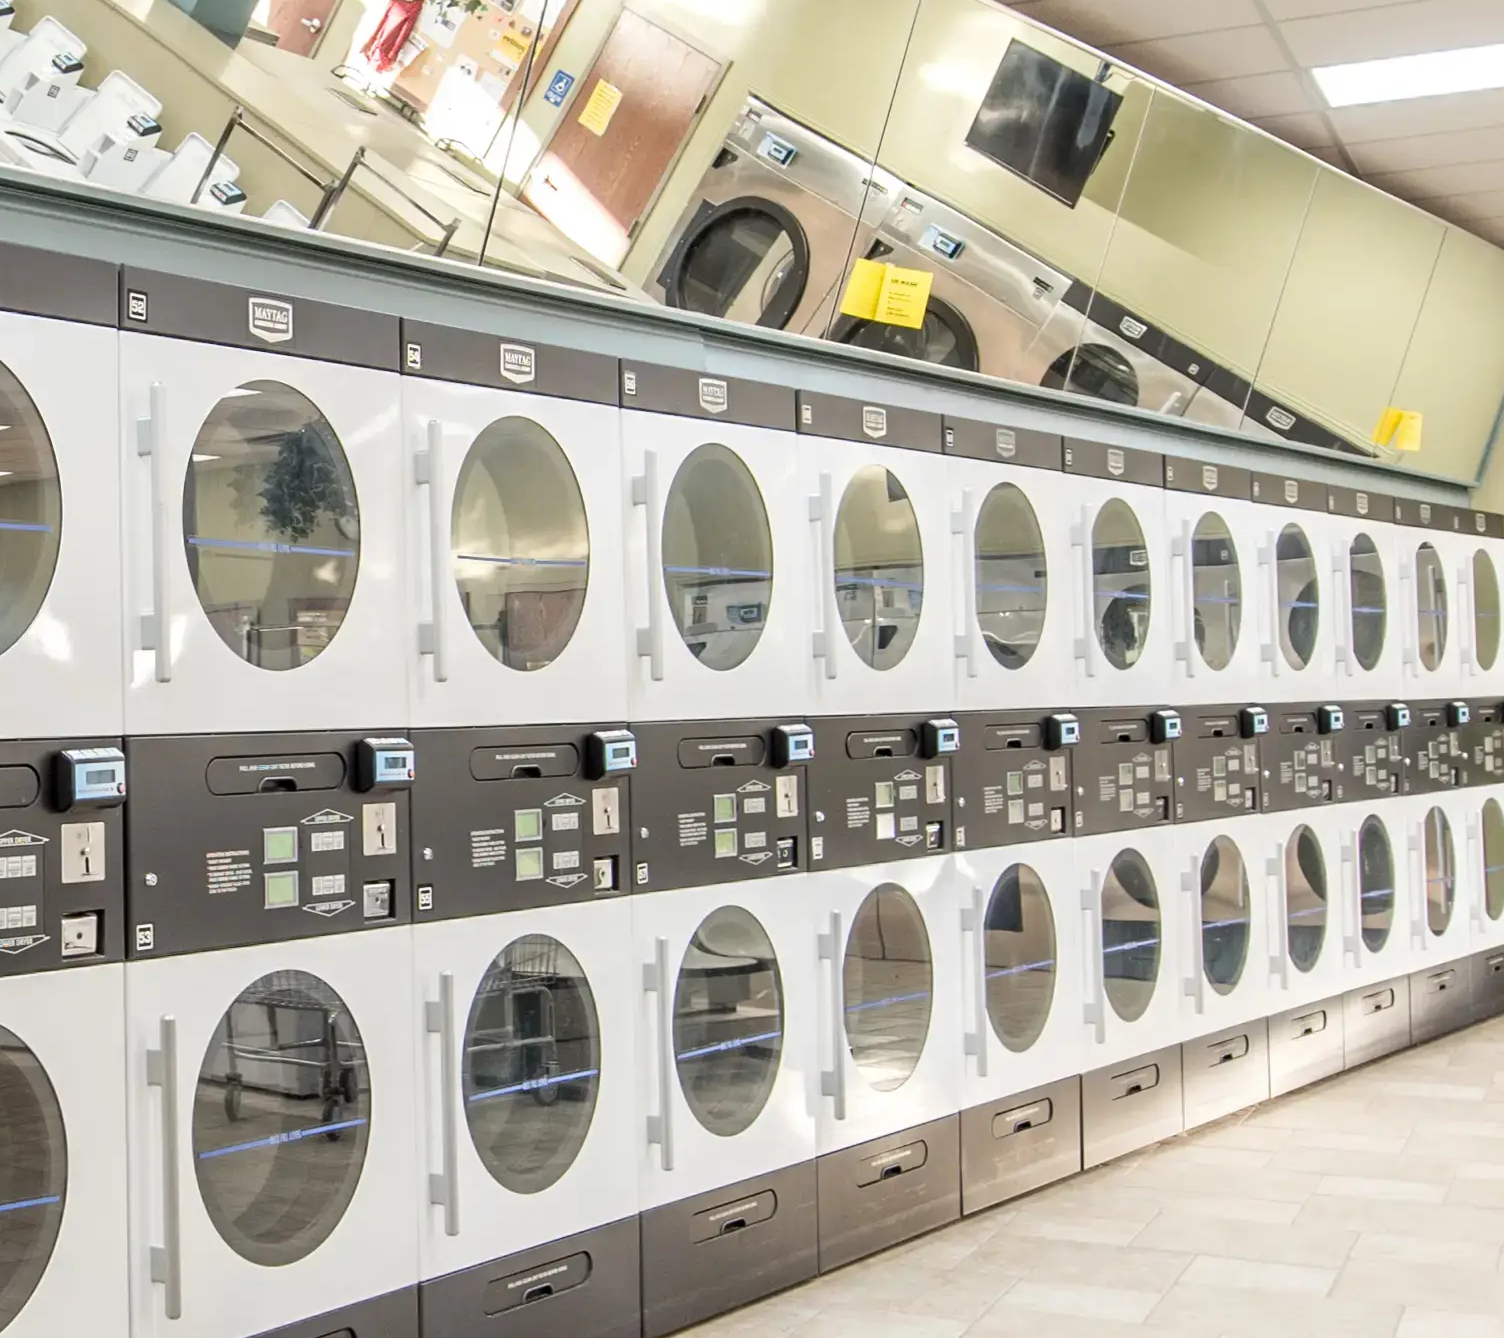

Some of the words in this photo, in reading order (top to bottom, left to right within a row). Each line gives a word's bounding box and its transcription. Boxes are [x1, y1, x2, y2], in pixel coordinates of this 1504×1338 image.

[131, 299, 146, 313] 52
[255, 306, 289, 324] MAYTAG
[505, 351, 531, 366] MAYTAG
[138, 931, 152, 944] 53
